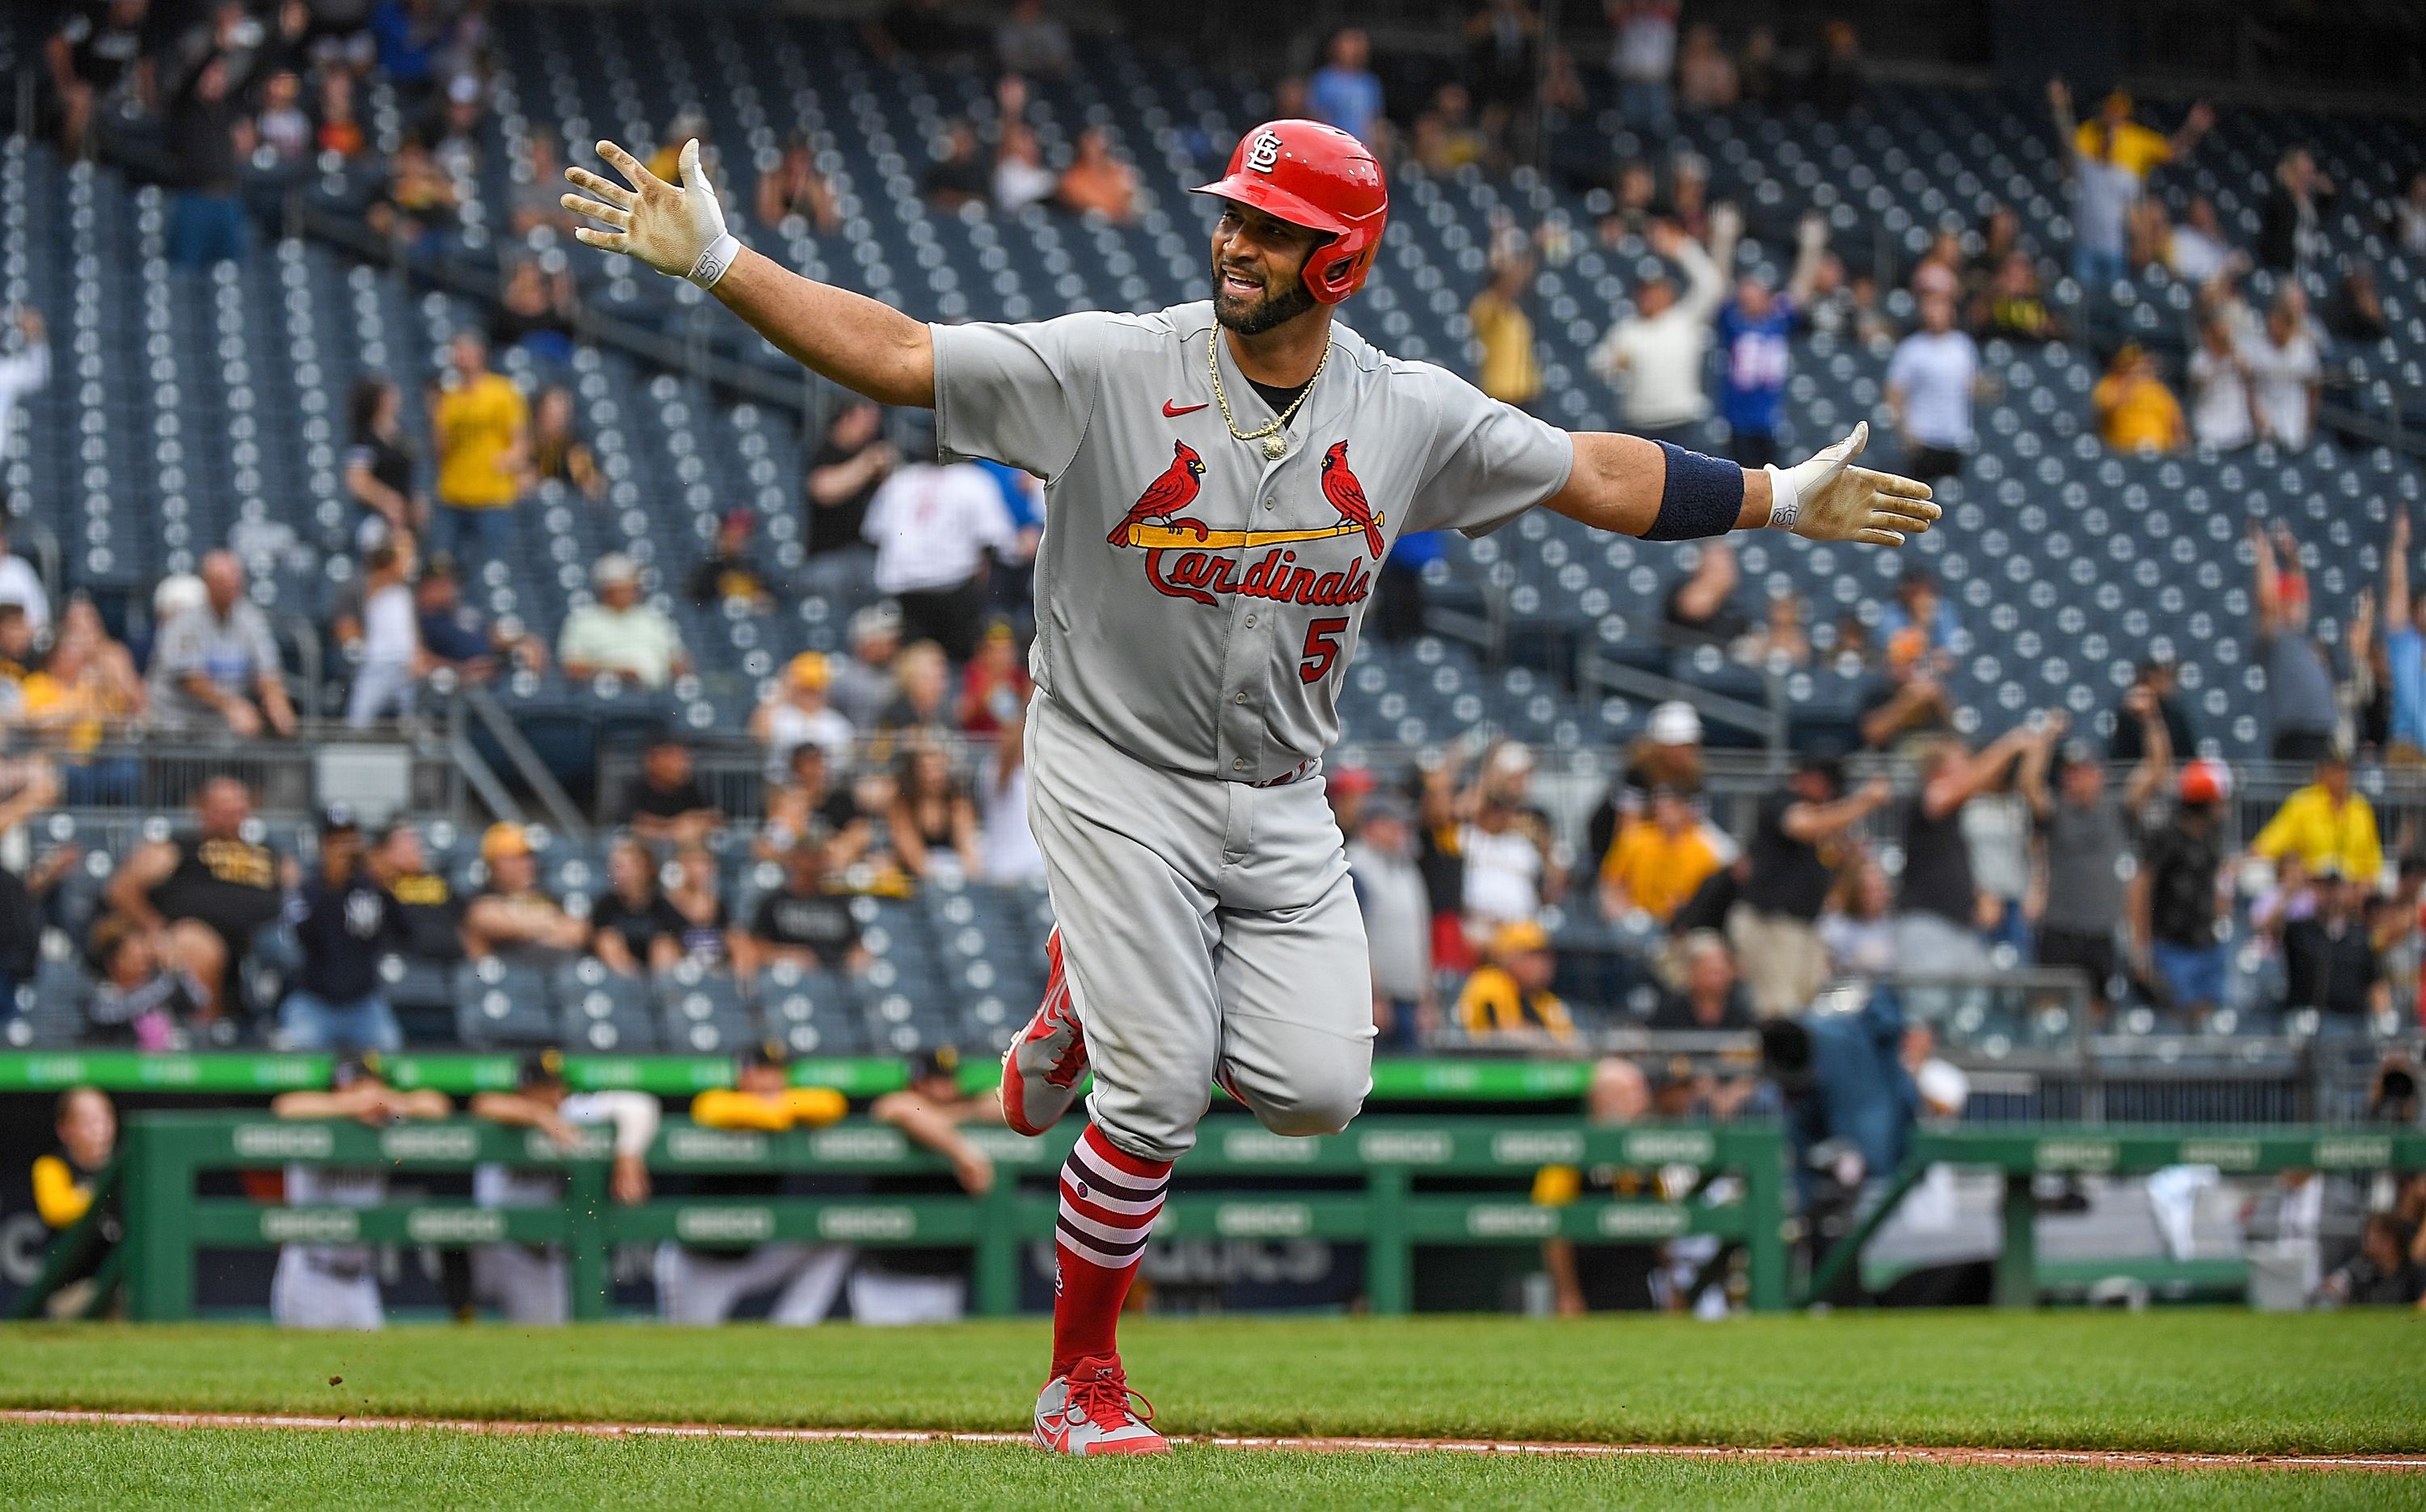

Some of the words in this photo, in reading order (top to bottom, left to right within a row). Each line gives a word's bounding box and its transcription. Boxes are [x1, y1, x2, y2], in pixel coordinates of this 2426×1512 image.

[695, 254, 720, 282] 5
[1145, 519, 1371, 606] Cardinals
[1299, 616, 1350, 685] 5
